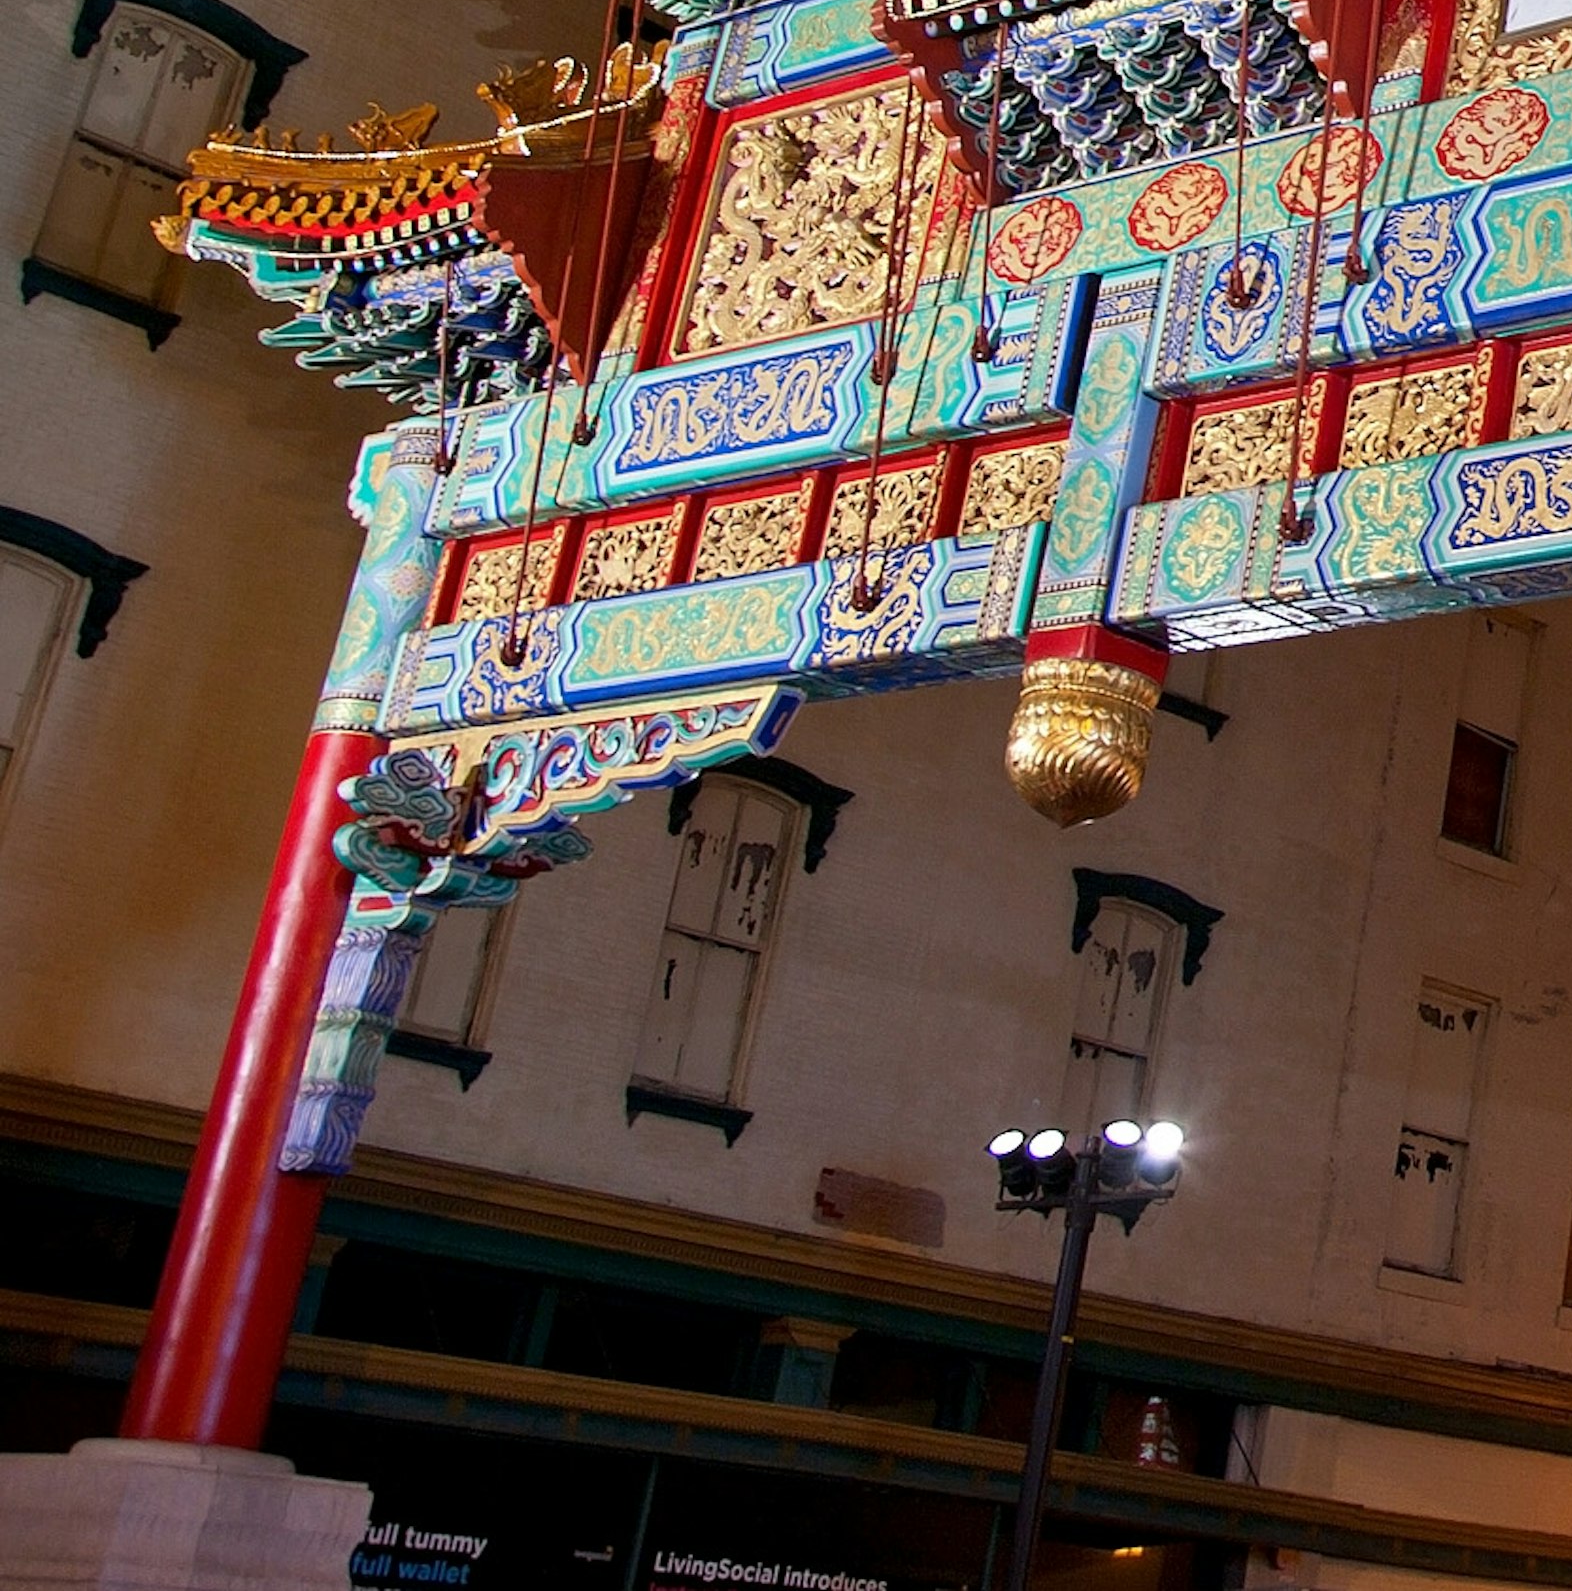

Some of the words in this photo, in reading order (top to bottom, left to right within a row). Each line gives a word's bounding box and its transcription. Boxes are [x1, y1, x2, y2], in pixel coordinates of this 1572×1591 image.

[365, 1521, 400, 1548] ull
[405, 1525, 488, 1559] tummy
[352, 1551, 391, 1577] full
[399, 1560, 471, 1585] wallet
[653, 1551, 779, 1584] LivingSocial
[783, 1564, 888, 1591] introduces
